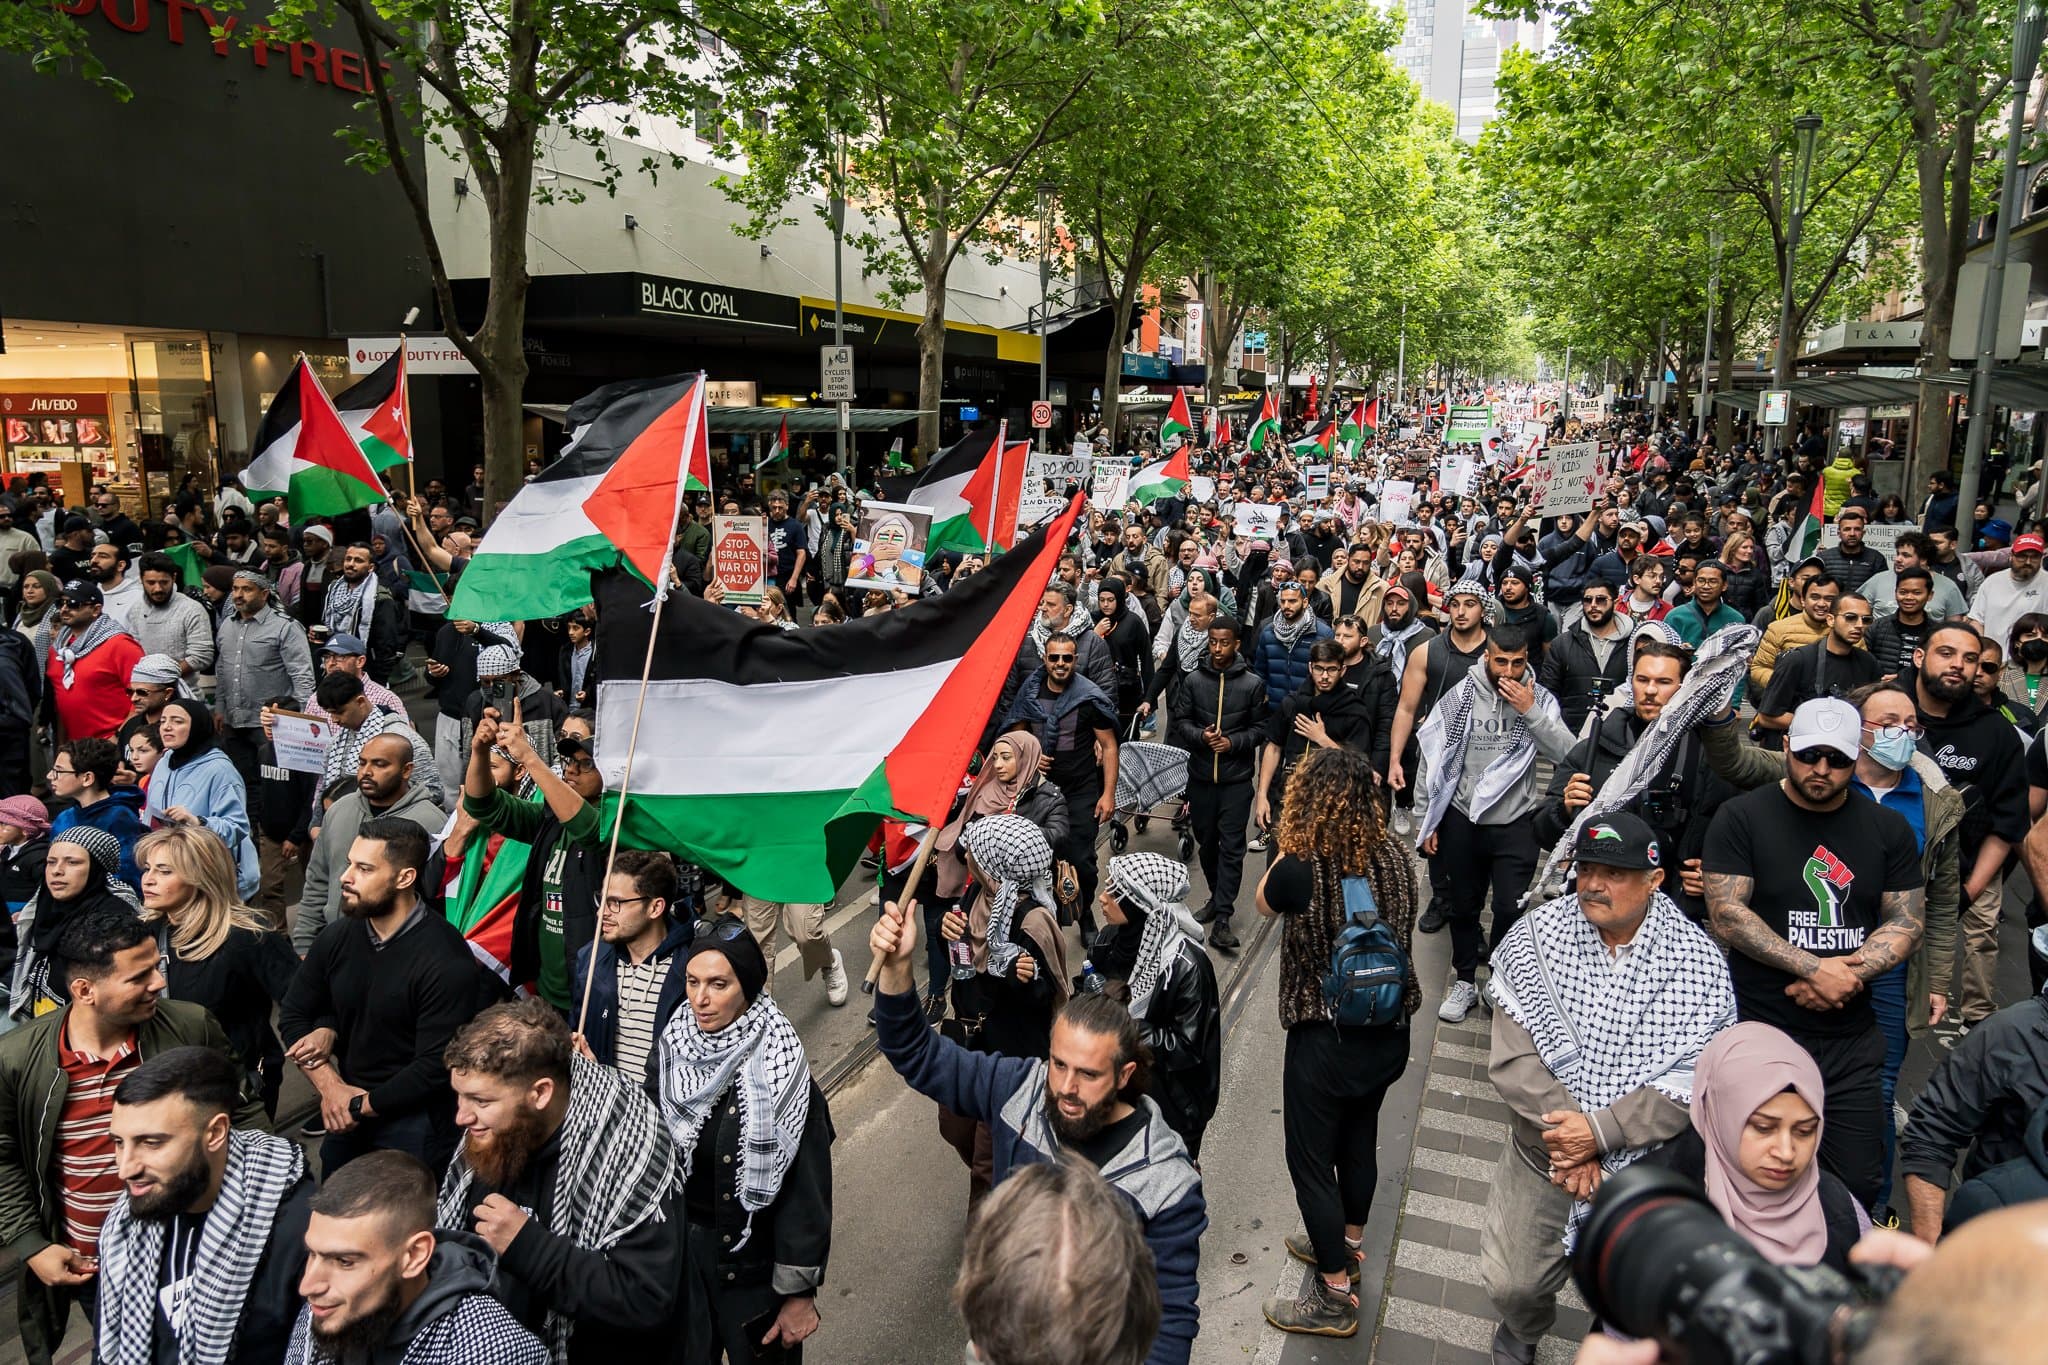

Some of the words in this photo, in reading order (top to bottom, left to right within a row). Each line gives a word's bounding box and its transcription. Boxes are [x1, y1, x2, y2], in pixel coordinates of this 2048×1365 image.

[55, 0, 238, 57] UTY
[642, 282, 694, 311] BLACK
[701, 291, 738, 316] OPAL
[368, 351, 397, 361] LOT
[408, 350, 440, 361] DUTY
[443, 350, 468, 361] FRE
[709, 391, 731, 399] CAFE
[28, 398, 78, 411] SHISEIDO
[1570, 400, 1579, 408] EE
[1036, 410, 1048, 418] 30
[1557, 447, 1589, 461] BOMBING
[1042, 462, 1057, 475] DO
[1060, 460, 1084, 474] YOU
[1561, 461, 1581, 474] KIDS
[1552, 477, 1564, 491] IS
[1568, 475, 1585, 488] NOT
[1549, 496, 1564, 507] SELF
[725, 538, 750, 549] STOP
[718, 550, 758, 561] ISRAEL'S
[718, 562, 741, 573] WAR
[743, 562, 758, 573] ON
[723, 574, 753, 585] GAZA!
[1788, 910, 1818, 927] FREE
[1788, 927, 1866, 950] PALESTINE
